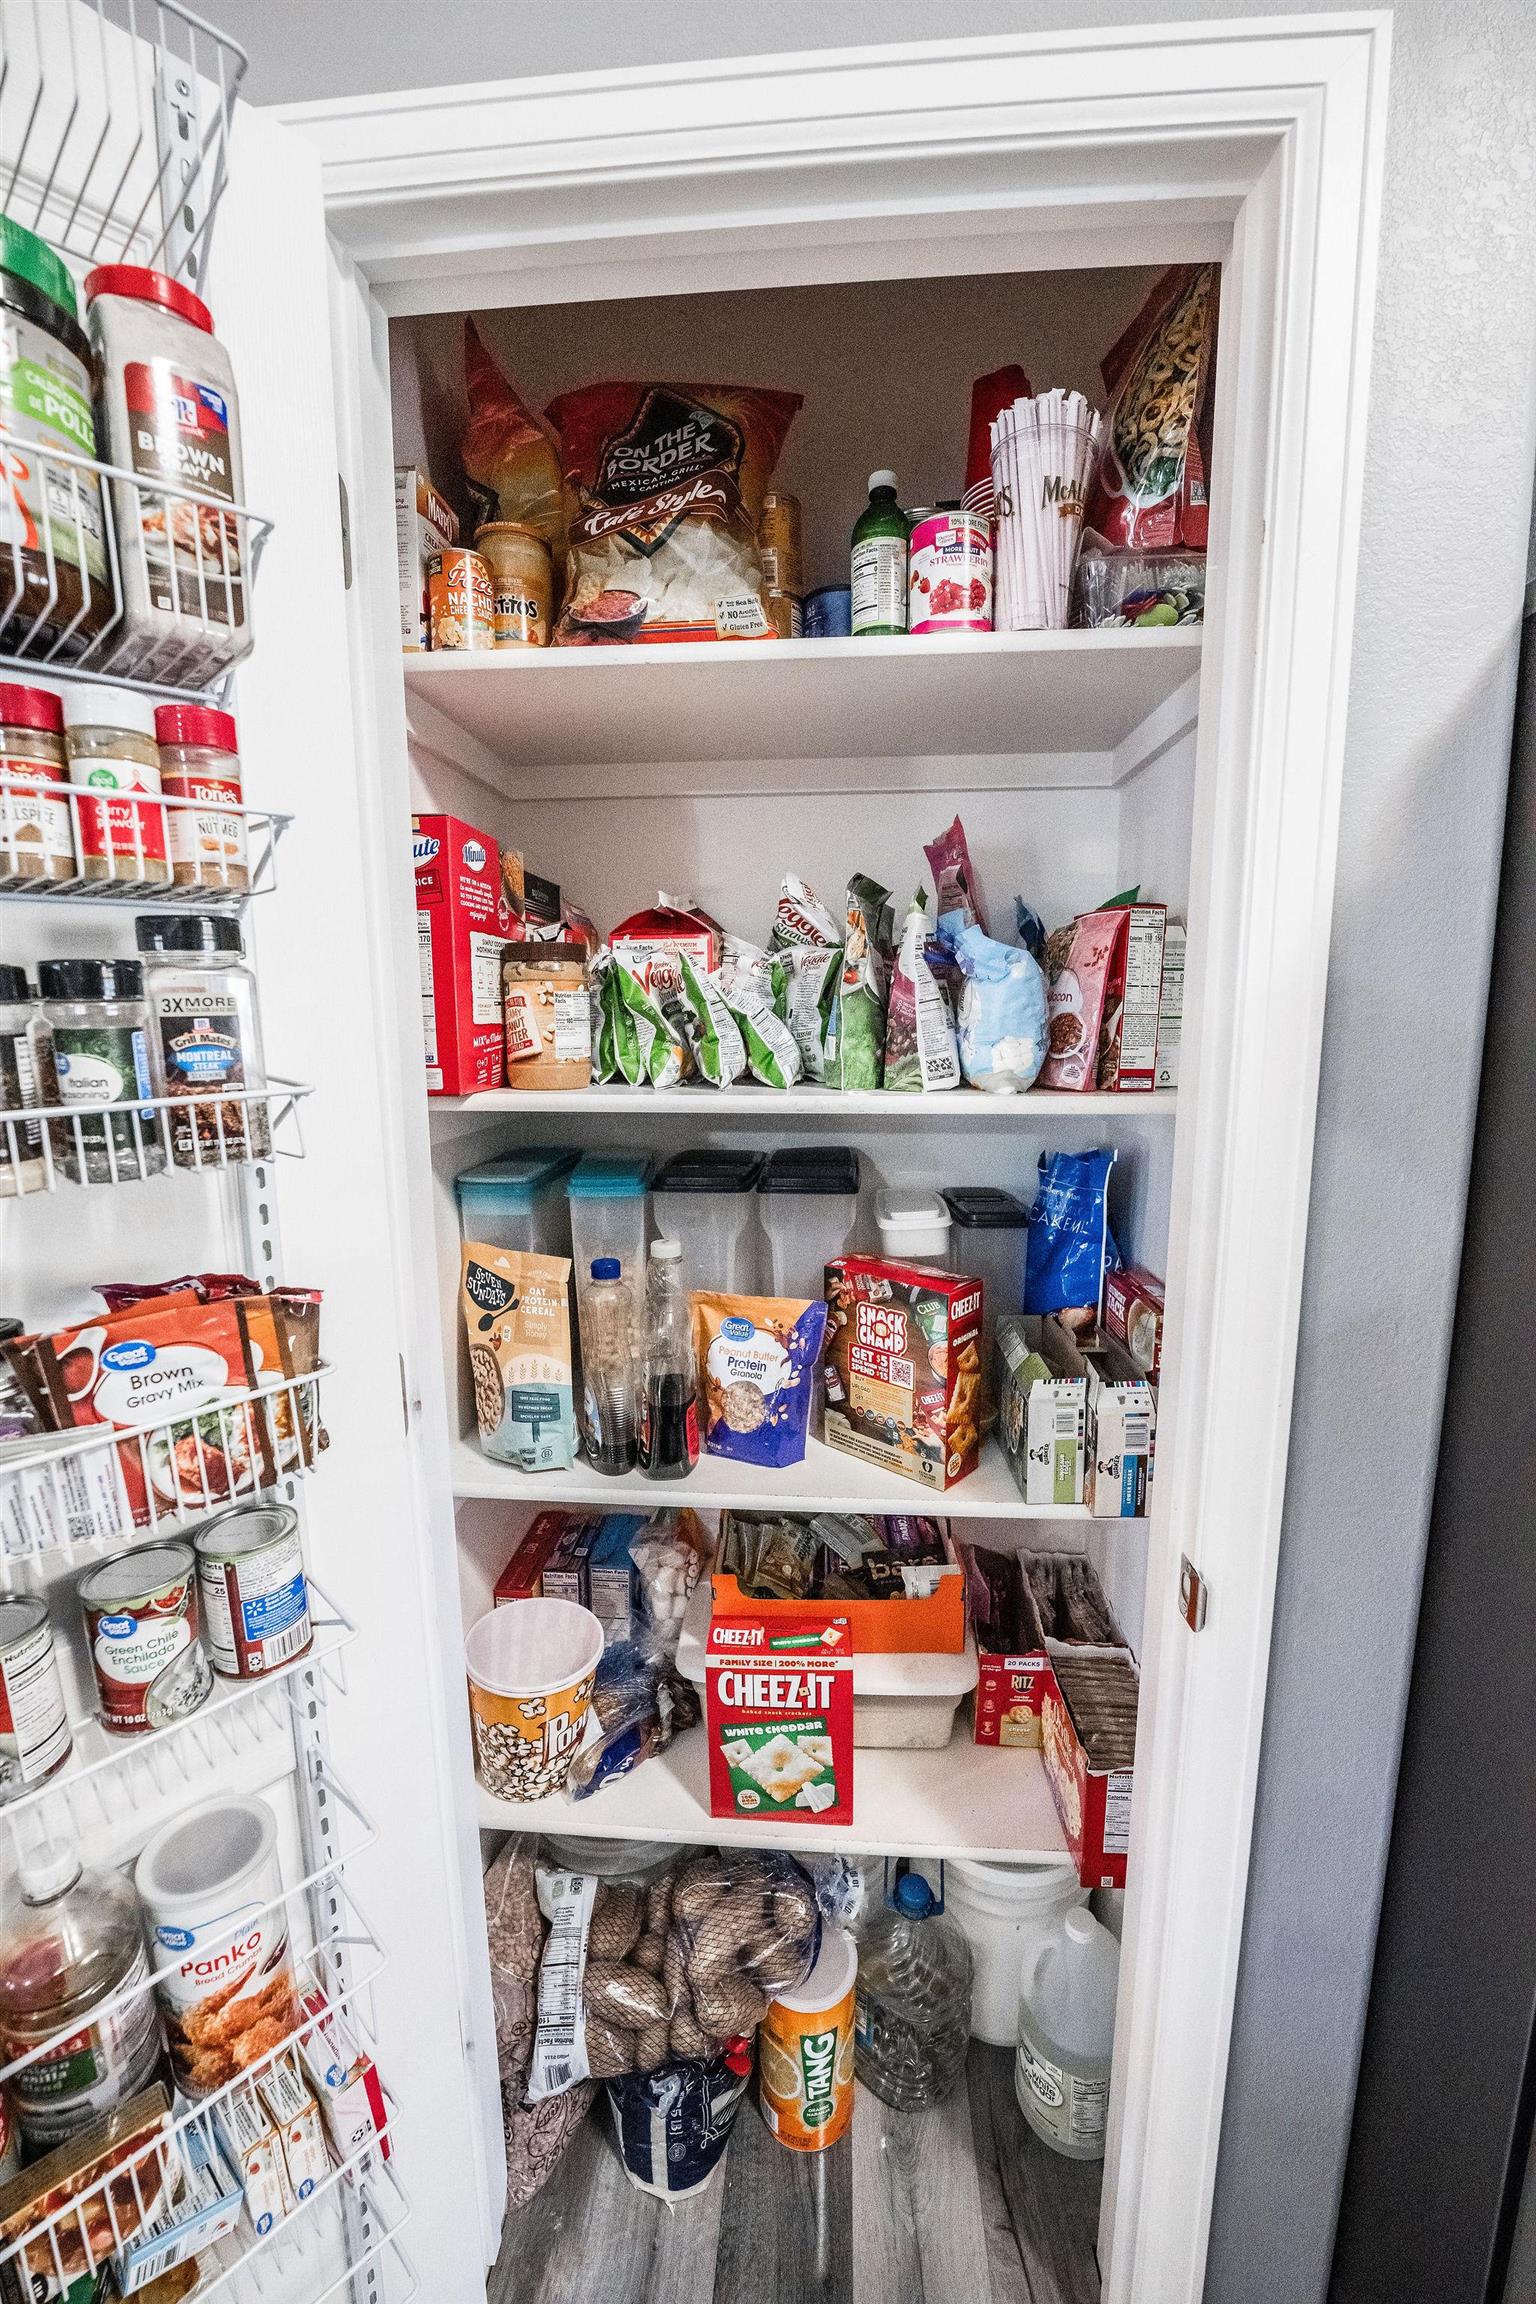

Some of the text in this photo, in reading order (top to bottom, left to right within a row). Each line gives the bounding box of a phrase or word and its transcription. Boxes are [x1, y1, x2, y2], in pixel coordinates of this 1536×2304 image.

[44, 394, 96, 453] POLL
[614, 422, 696, 458] ON THE
[138, 430, 225, 475] BOWN
[607, 433, 717, 479] BORDER
[611, 465, 700, 490] MEXICAN GRILL
[640, 476, 680, 492] CANTINA
[585, 480, 726, 535] Café Style
[727, 611, 738, 619] NO
[729, 623, 749, 631] Gluten
[413, 839, 439, 858] ute
[162, 997, 236, 1013] 3X MORE
[175, 1034, 231, 1048] Grill Mates
[176, 1050, 234, 1063] MONTREAL
[193, 1062, 220, 1071] STEAK
[476, 1268, 502, 1289] SEVEN
[467, 1277, 506, 1306] SUNDAYS
[529, 1287, 546, 1297] OAT
[521, 1306, 555, 1316] CEREAL
[917, 1302, 940, 1315] CLUB
[951, 1292, 981, 1321] CHEEZ-IT
[725, 1321, 749, 1332] Great
[859, 1306, 904, 1335] SNACK
[729, 1329, 749, 1337] Value
[859, 1326, 904, 1354] CHAMP
[719, 1346, 778, 1361] Peanut Butter
[852, 1347, 888, 1367] GET $5
[728, 1357, 767, 1372] Protein
[851, 1363, 888, 1381] SPEND $15
[131, 1366, 193, 1390] Brown
[730, 1369, 762, 1380] Granola
[126, 1379, 205, 1408] Gravy Mix
[105, 1630, 179, 1656] Green Chile
[713, 1627, 761, 1645] CHEEZ-IT
[112, 1643, 175, 1666] Enchilada
[124, 1660, 165, 1675] Sauce
[718, 1671, 836, 1709] CHEEZ-IT
[1011, 1675, 1035, 1689] RITZ
[725, 1722, 822, 1737] WHITE CHEDDAR
[181, 1932, 261, 1977] Panko
[195, 1972, 225, 1985] Bread
[804, 2032, 835, 2100] TANG
